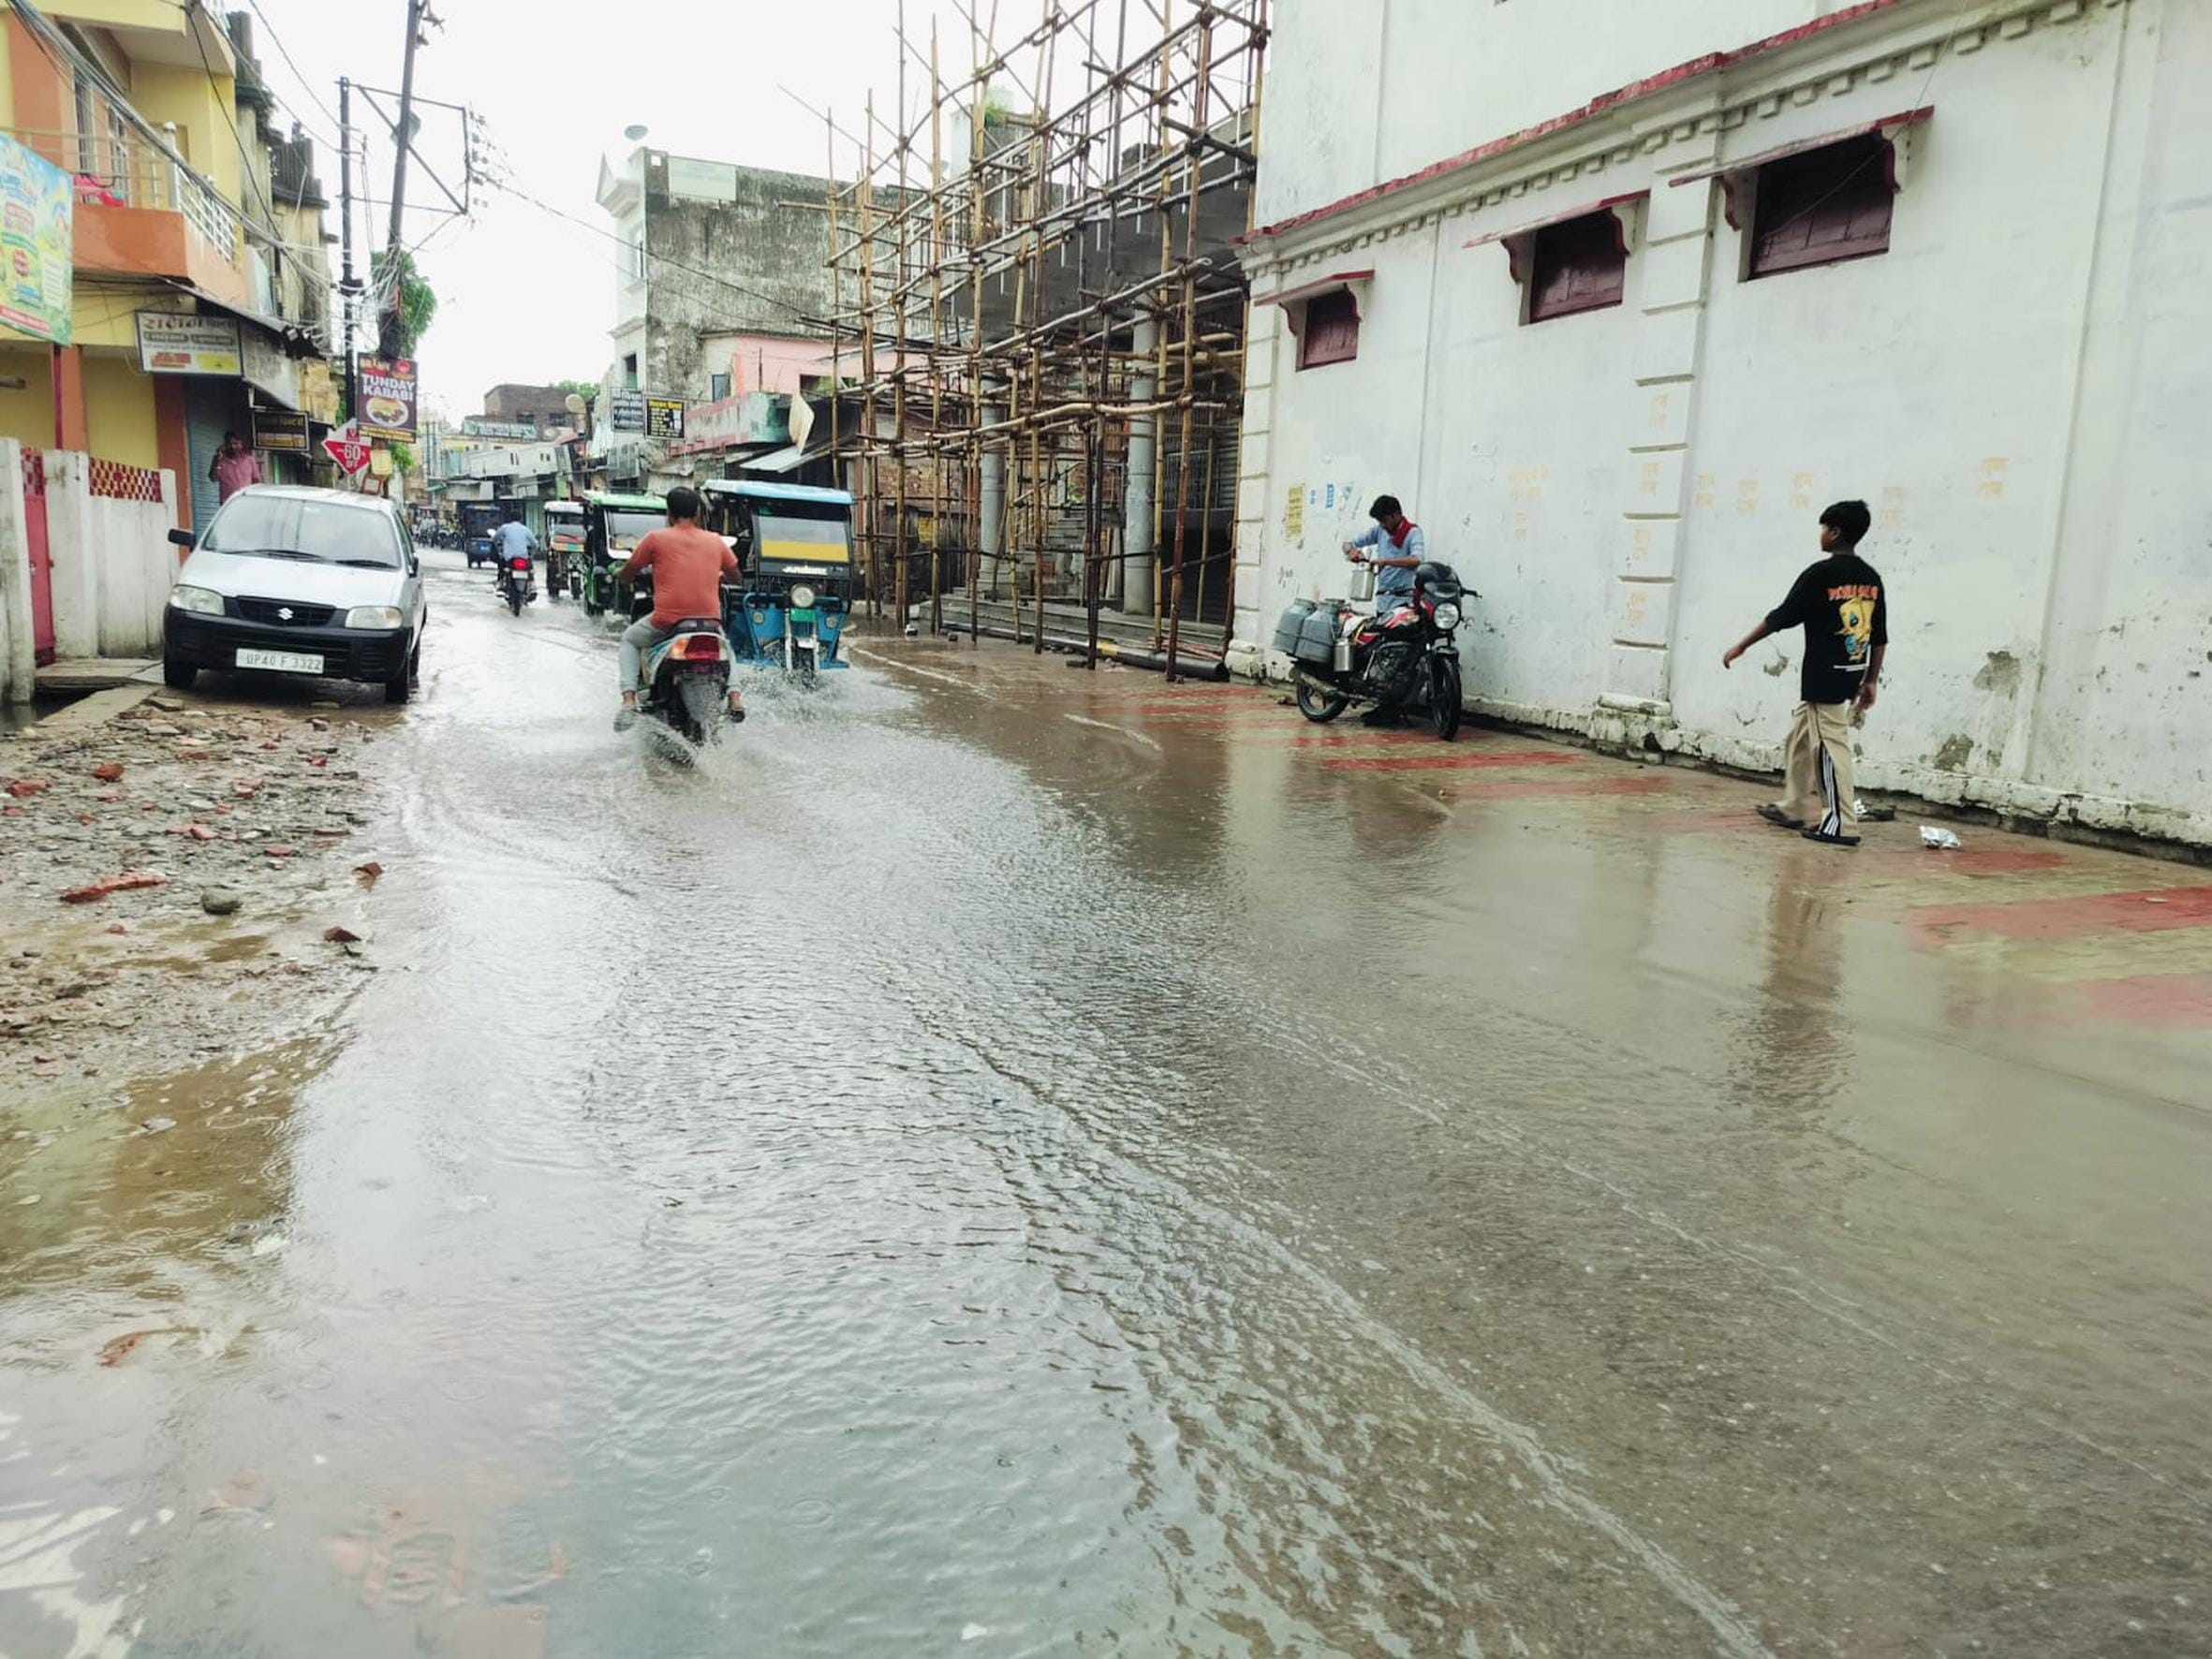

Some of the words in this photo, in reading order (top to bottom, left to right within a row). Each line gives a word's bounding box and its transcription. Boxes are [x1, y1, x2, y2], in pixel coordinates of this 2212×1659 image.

[361, 374, 415, 392] TUNDAY
[246, 653, 276, 667] UP40
[281, 656, 288, 667] F
[292, 657, 321, 670] 3322
